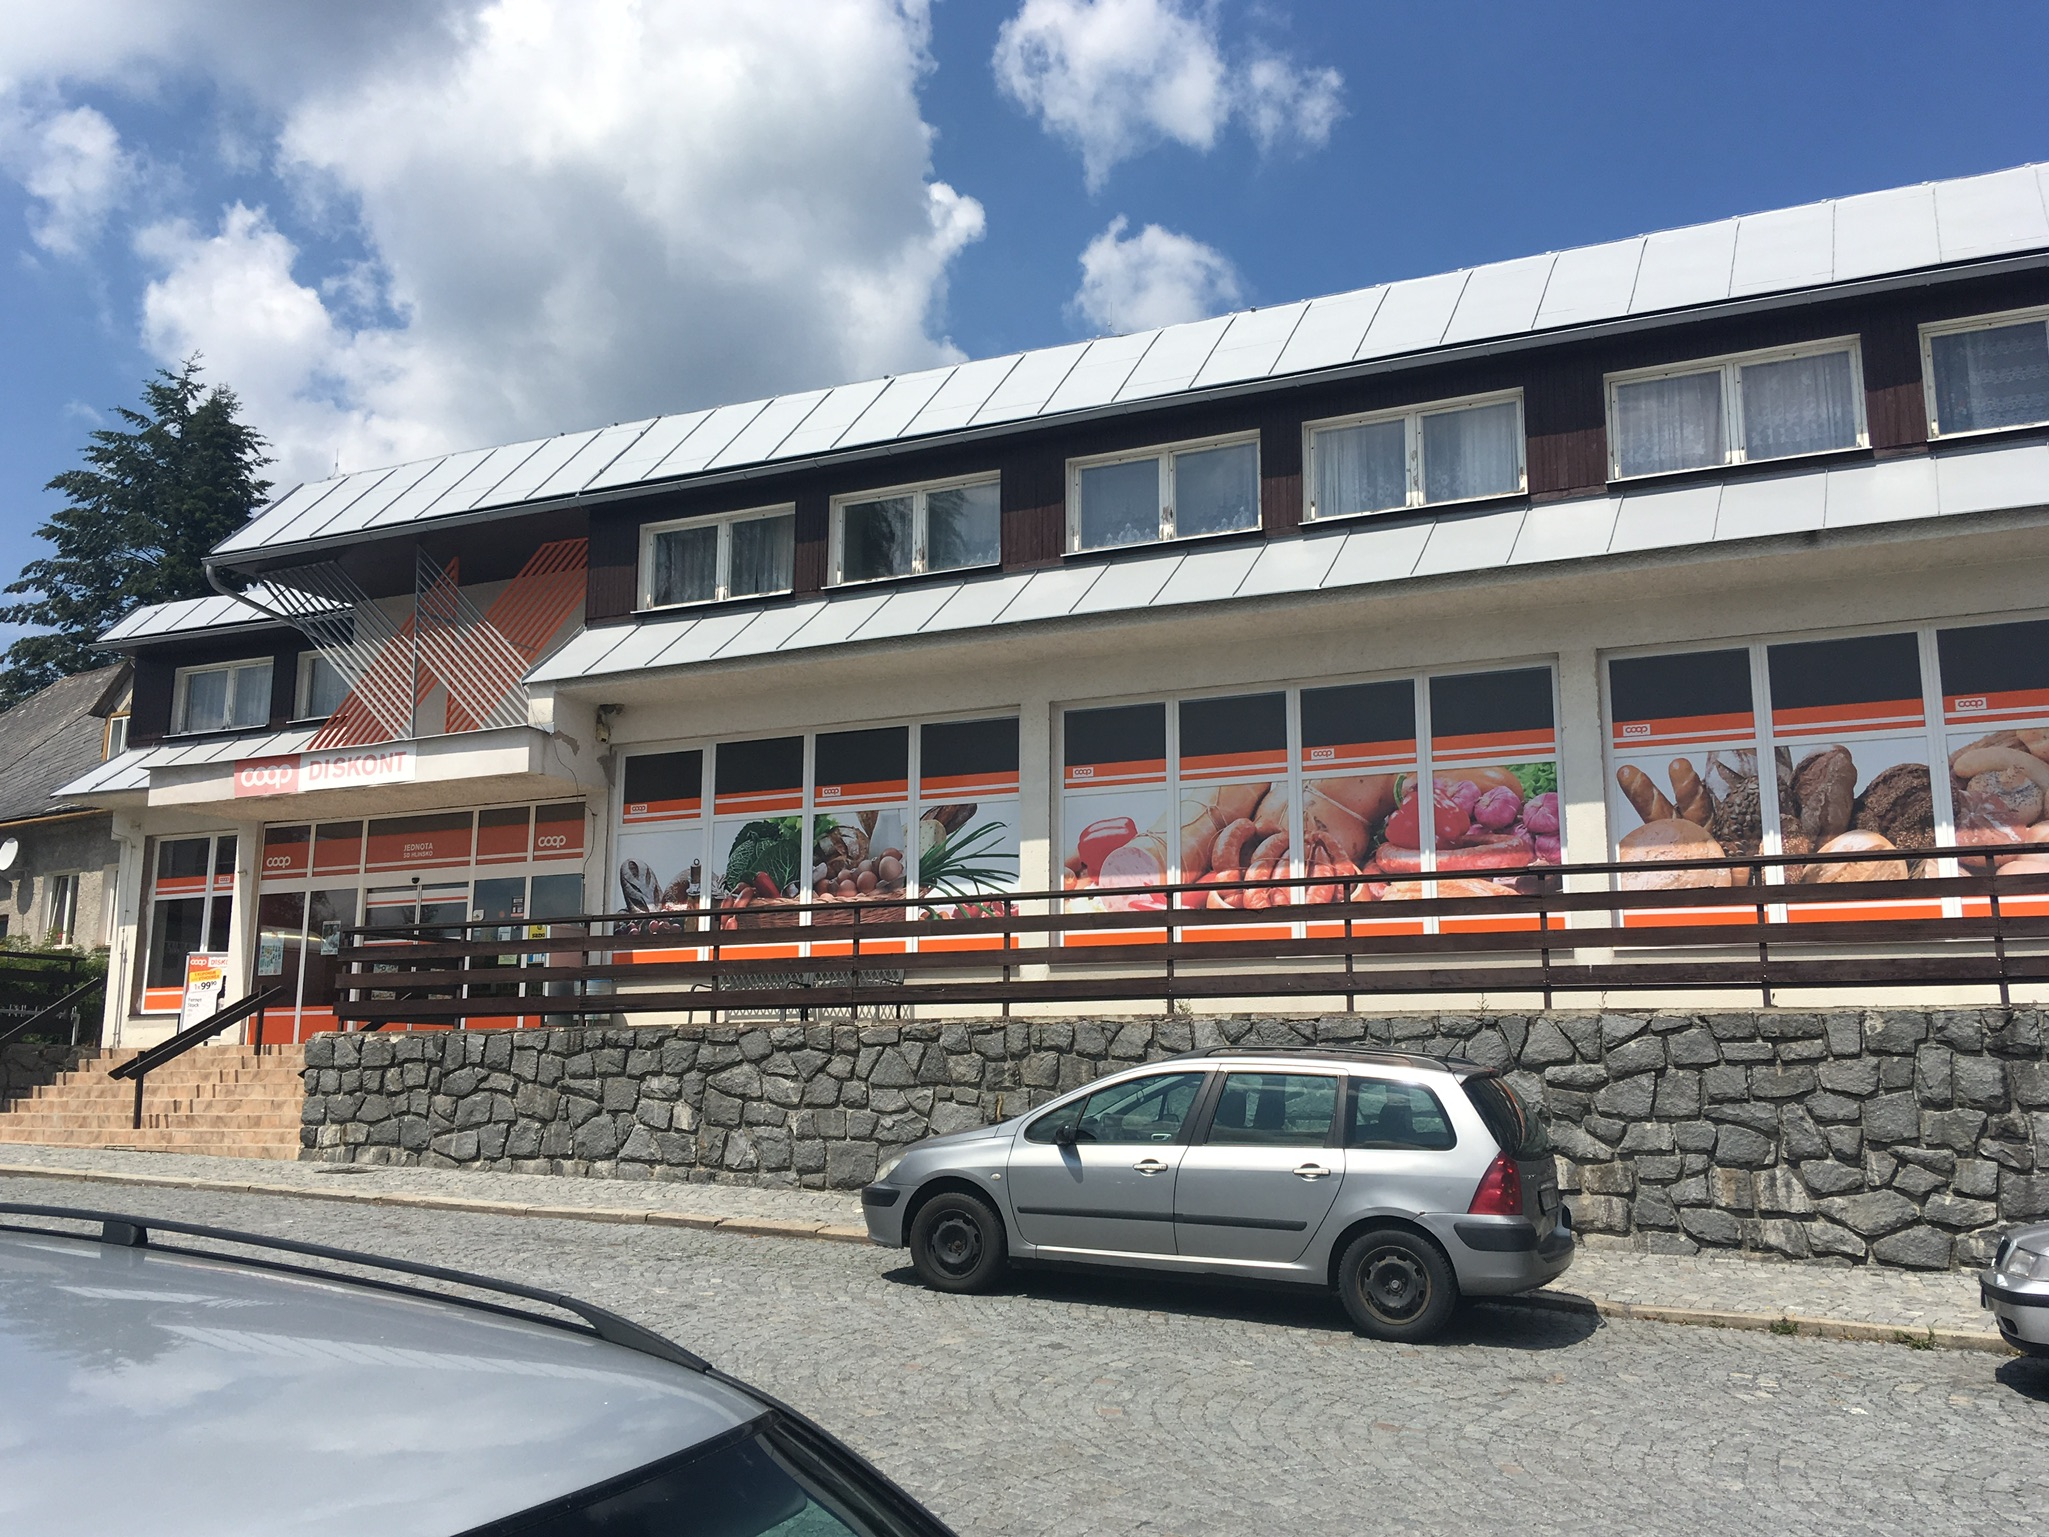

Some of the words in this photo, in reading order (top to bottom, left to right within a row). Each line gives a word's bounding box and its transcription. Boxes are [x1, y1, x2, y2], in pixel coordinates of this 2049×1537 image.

[1958, 699, 1983, 708] coop
[1625, 726, 1648, 734] coop
[240, 763, 293, 789] coop
[309, 751, 407, 781] DISKONT
[403, 842, 434, 852] JEDNOTA
[538, 835, 567, 848] coop
[266, 856, 291, 868] coop
